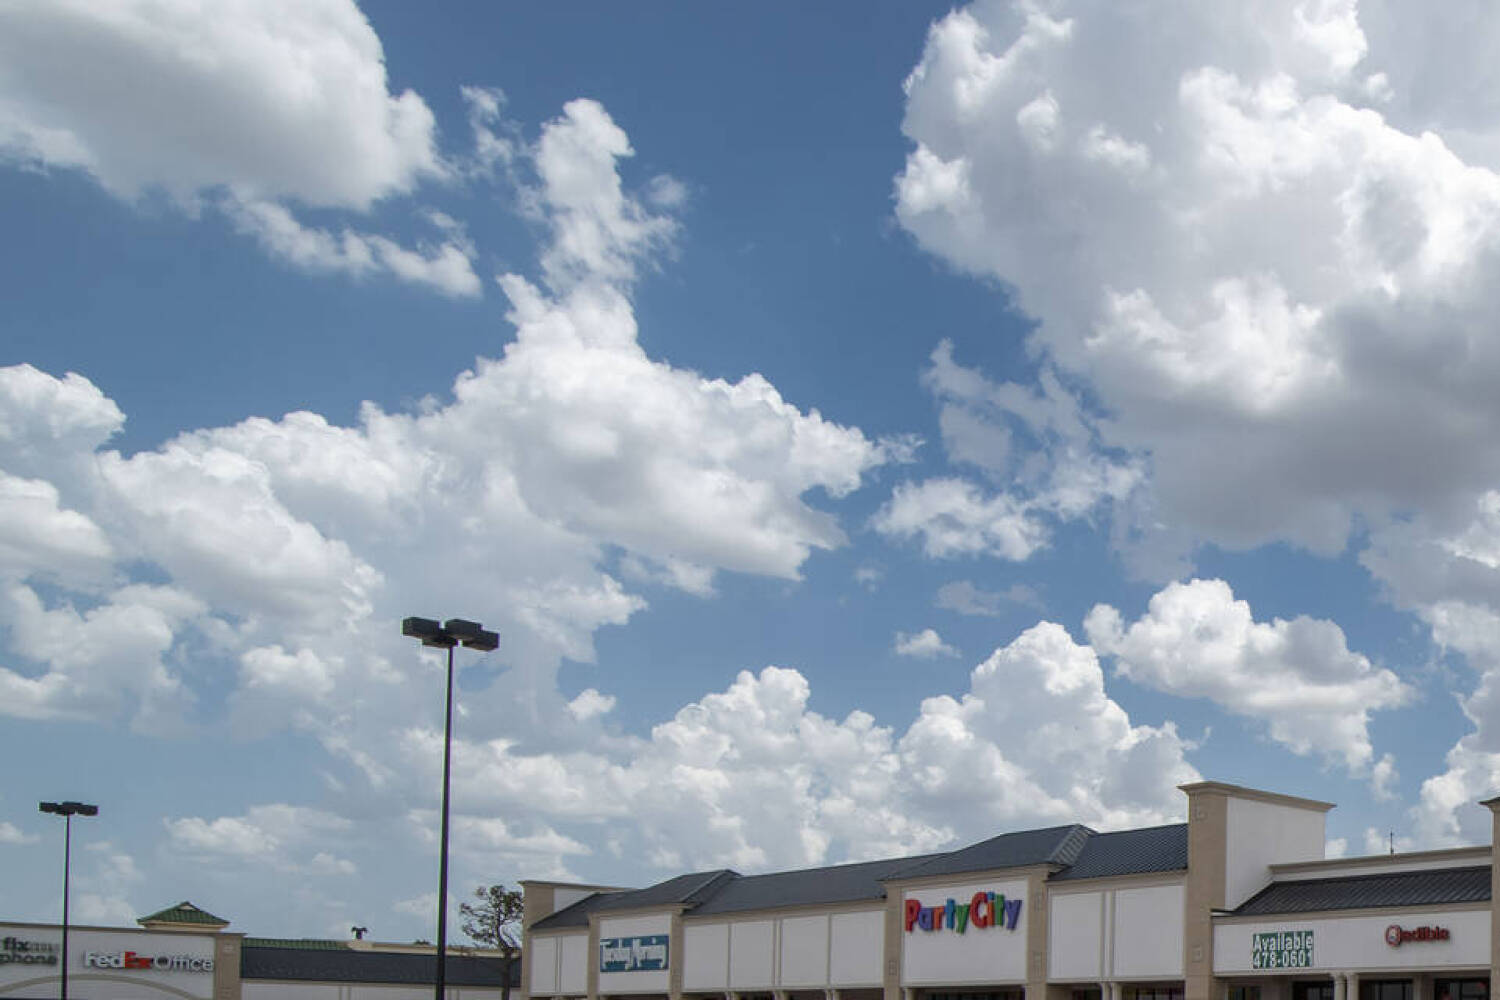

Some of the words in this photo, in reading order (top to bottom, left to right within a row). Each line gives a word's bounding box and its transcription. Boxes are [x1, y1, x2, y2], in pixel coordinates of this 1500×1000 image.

[904, 897, 970, 934] Party
[970, 891, 1023, 931] City
[1253, 931, 1312, 952] Available
[84, 950, 154, 969] FedEx
[154, 952, 214, 973] Office
[1252, 951, 1312, 968] 478-0601
